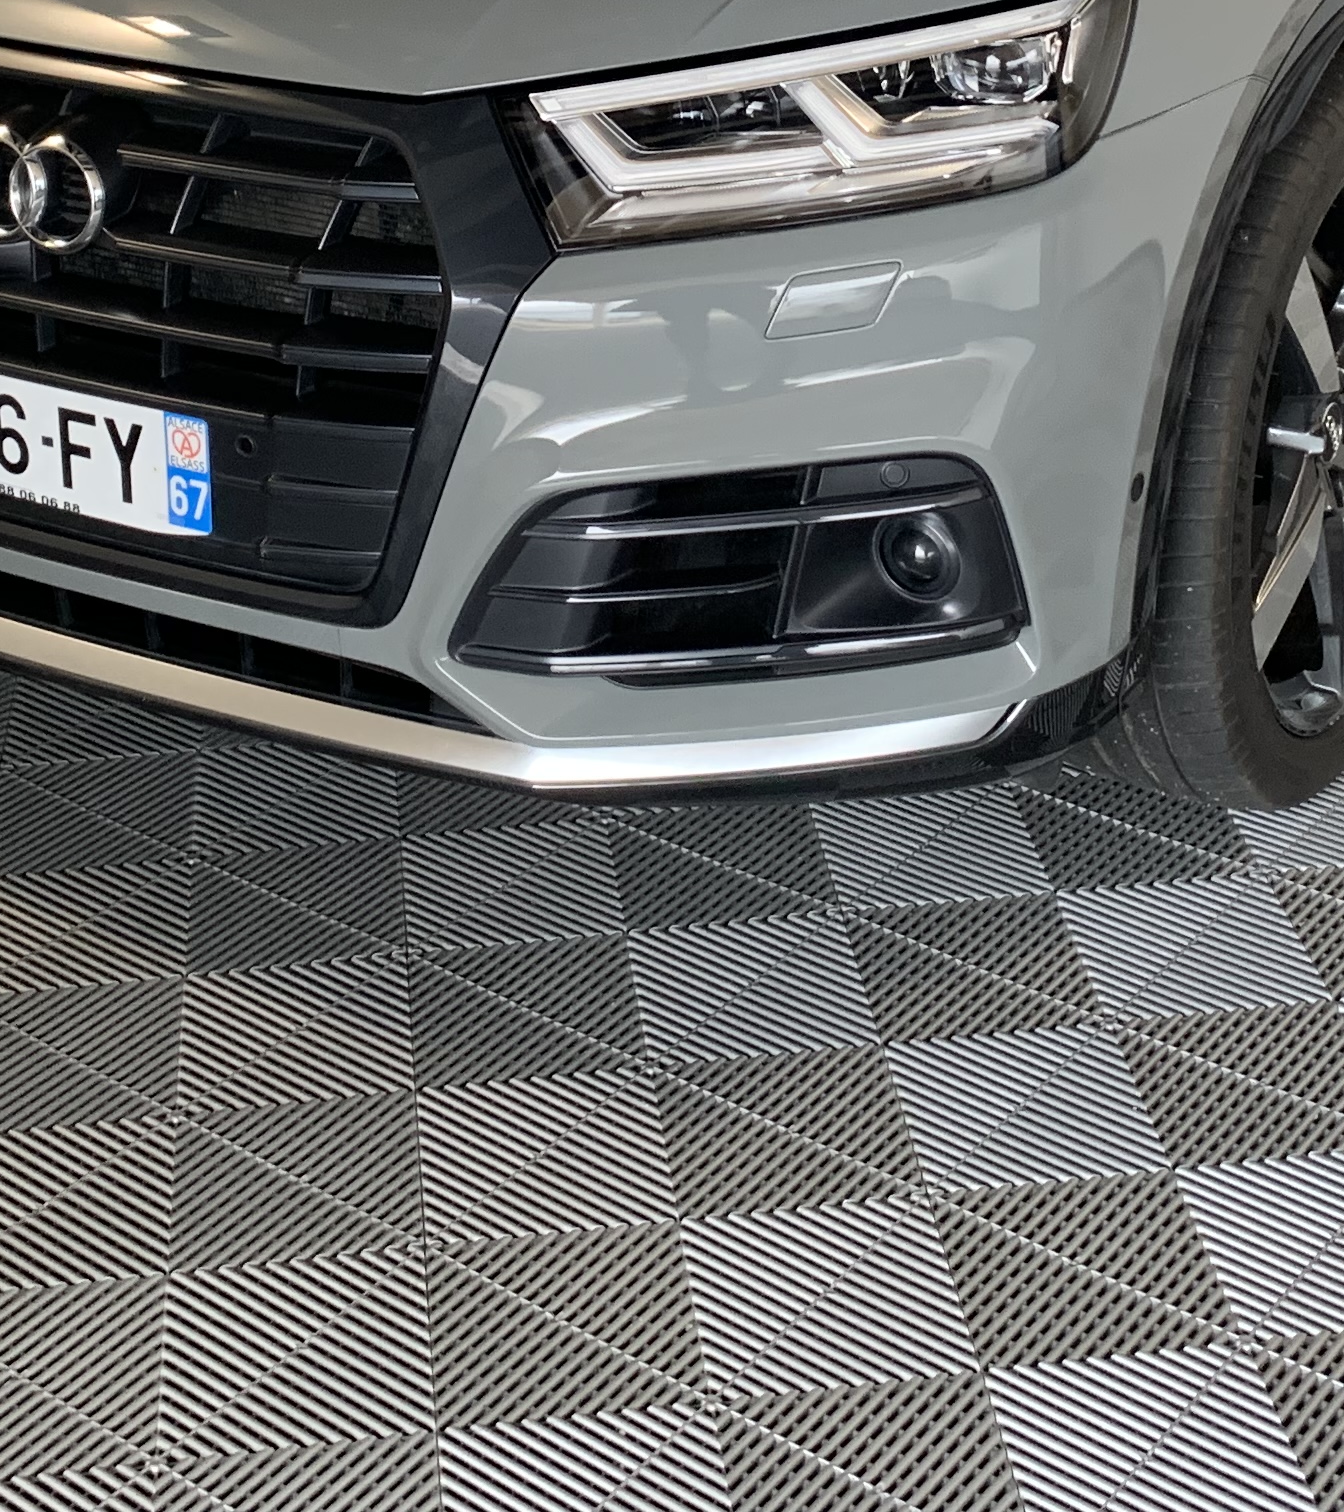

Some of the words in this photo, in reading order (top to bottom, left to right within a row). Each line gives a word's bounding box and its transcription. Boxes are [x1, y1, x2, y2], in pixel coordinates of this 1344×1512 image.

[167, 416, 205, 434] ALSACE
[170, 455, 205, 473] ELSASS
[169, 474, 209, 521] 67
